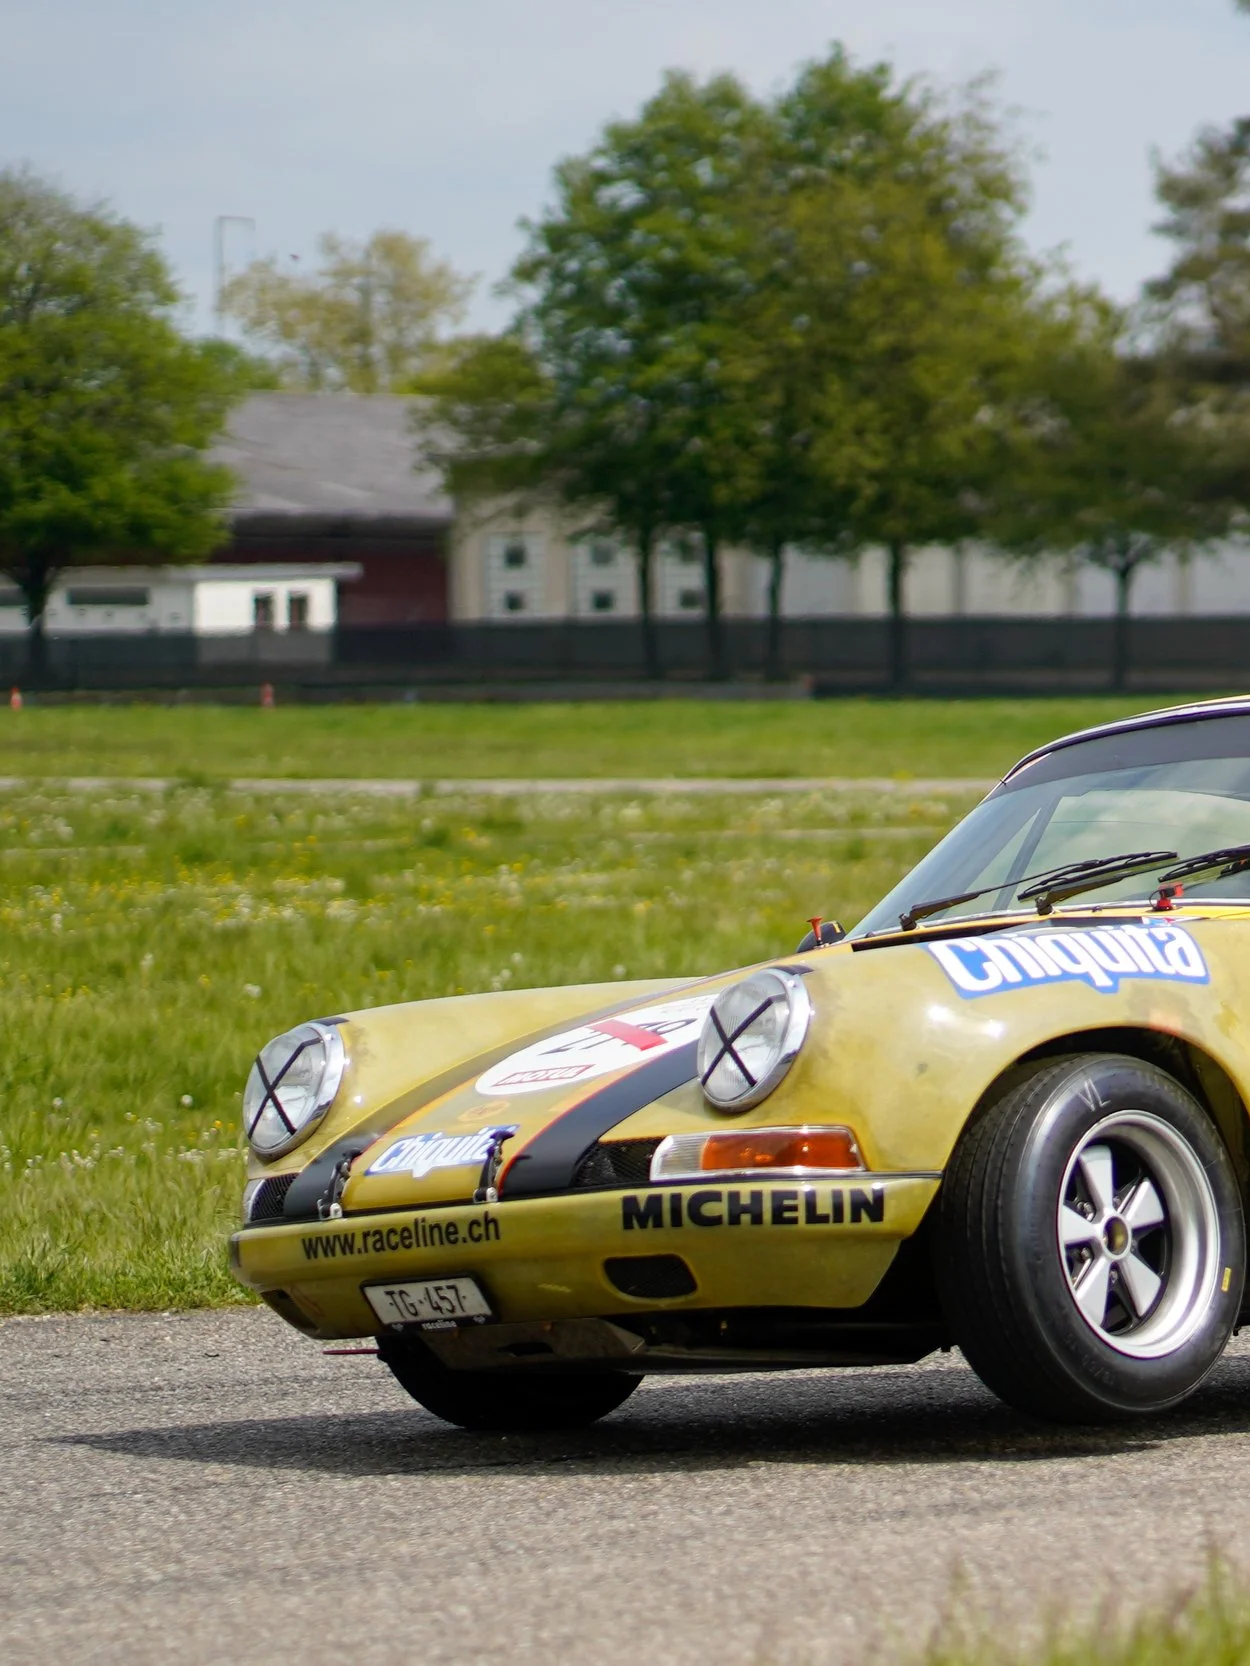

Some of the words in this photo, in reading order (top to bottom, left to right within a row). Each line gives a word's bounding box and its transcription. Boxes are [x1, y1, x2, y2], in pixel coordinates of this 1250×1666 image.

[928, 924, 1206, 991] Chiquita
[621, 1188, 885, 1230] MICHELIN
[302, 1211, 500, 1260] www.raceline.ch
